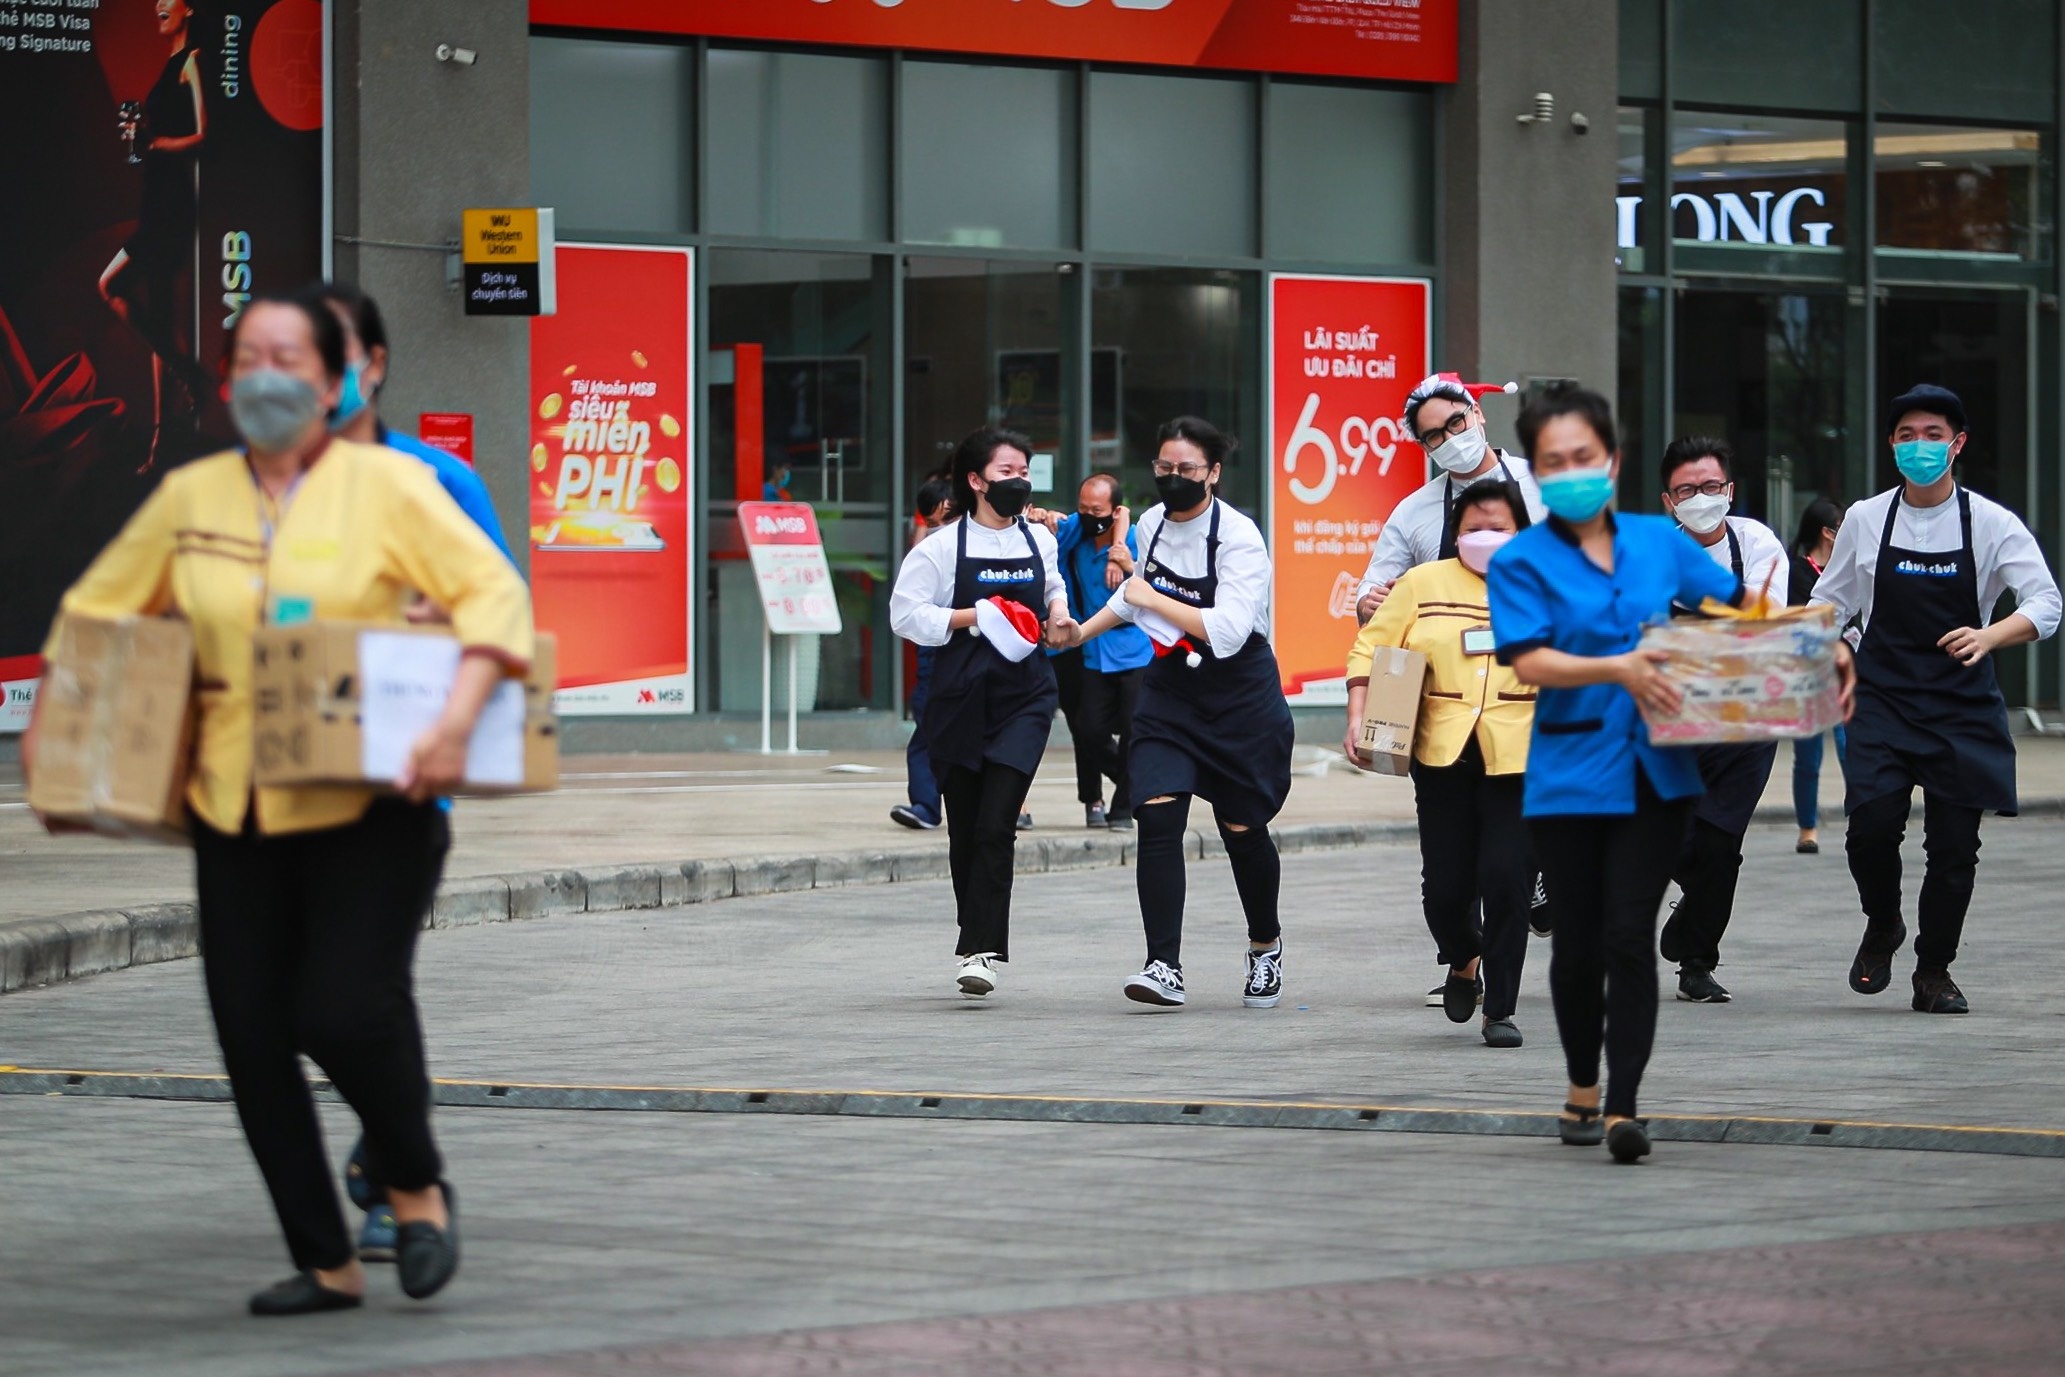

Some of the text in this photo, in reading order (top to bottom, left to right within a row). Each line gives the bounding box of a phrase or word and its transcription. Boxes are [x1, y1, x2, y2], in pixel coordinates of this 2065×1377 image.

[23, 12, 56, 28] MSB
[60, 14, 91, 30] Visa
[20, 34, 92, 52] Signature
[221, 14, 241, 99] dining
[481, 230, 523, 241] Western
[487, 243, 517, 255] Union
[222, 230, 252, 330] MSB
[481, 272, 517, 286] Dịch vụ
[1304, 324, 1379, 352] LÃI SUẤT
[1304, 355, 1396, 379] ƯU ĐÃI CHỈ
[571, 379, 590, 395] Tài
[628, 381, 657, 397] MSB
[568, 394, 615, 420] siêu
[563, 401, 650, 452] miễn
[556, 445, 646, 511] PHÍ
[11, 688, 32, 701] Thẻ
[658, 689, 684, 703] MSB
